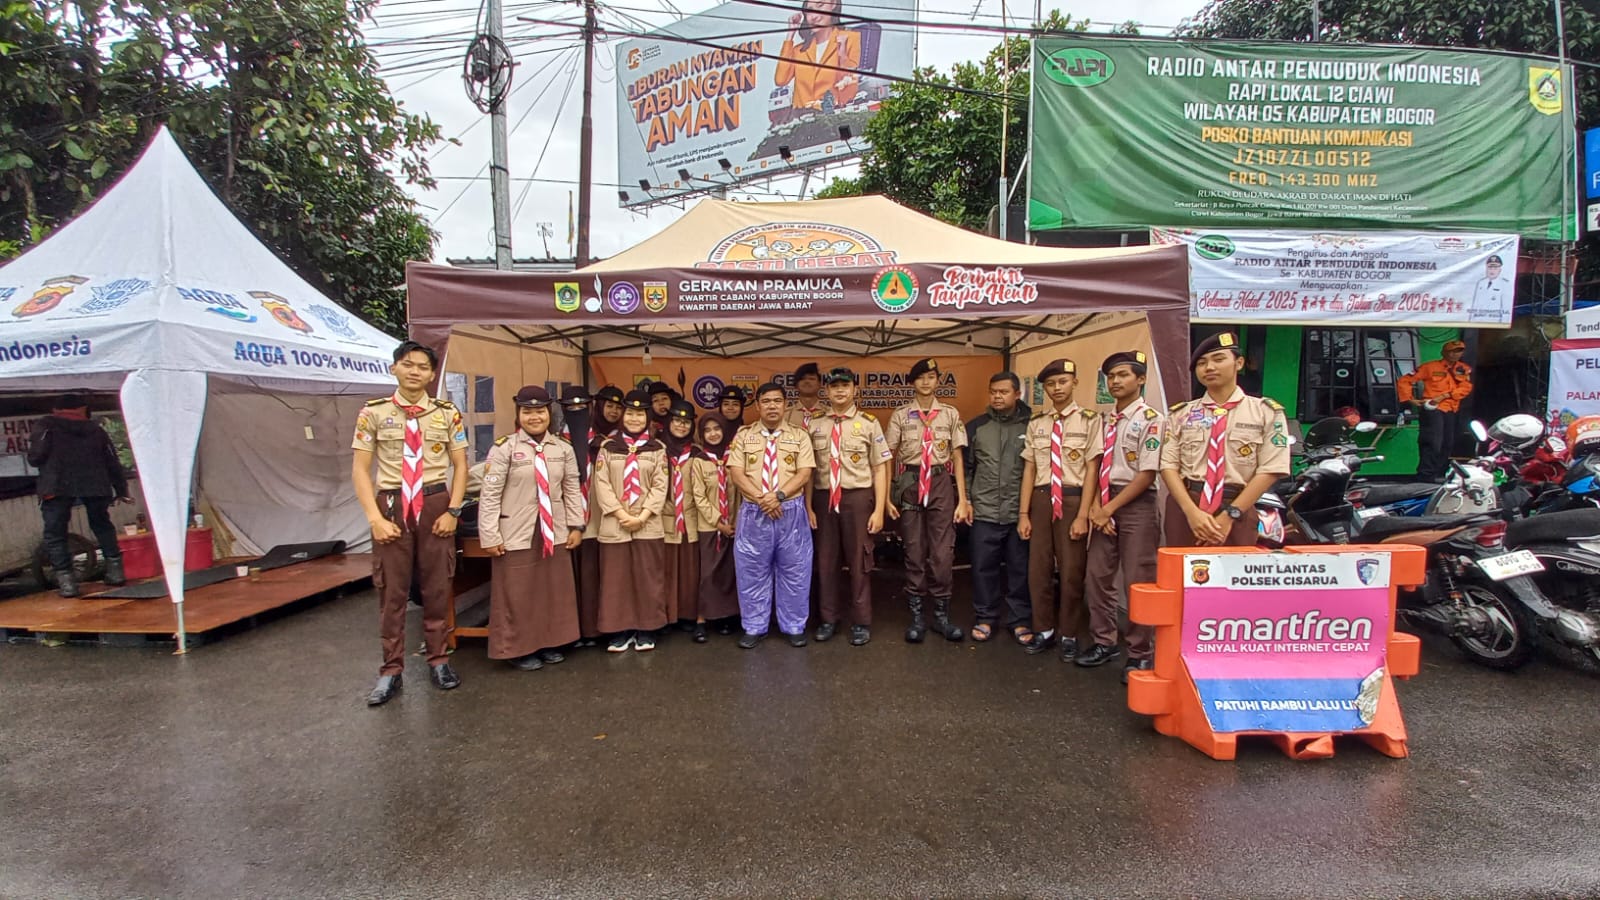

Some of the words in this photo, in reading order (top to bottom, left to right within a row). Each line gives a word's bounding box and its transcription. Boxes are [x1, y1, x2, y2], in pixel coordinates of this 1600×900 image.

[627, 59, 689, 101] LIBURAN
[691, 40, 763, 75] NYAMAN
[1147, 57, 1205, 77] RADIO
[1211, 58, 1279, 79] ANTAR
[1283, 59, 1380, 81] PENDUDUK
[1388, 63, 1481, 86] INDONESIA
[633, 63, 757, 123] TABUNGAN
[1228, 84, 1266, 101] RAPI
[1271, 84, 1325, 102] LOKAL
[1328, 85, 1344, 102] 12
[1348, 86, 1394, 105] CIAWI
[1183, 102, 1258, 121] WILAYAH
[1262, 103, 1282, 121] 05
[1287, 103, 1380, 124] KABUPATEN
[1385, 108, 1435, 125] BOGOR
[646, 94, 741, 152] AMAN
[1201, 127, 1249, 143] POSKO
[1251, 128, 1321, 145] BANTUAN
[1324, 129, 1413, 147] KOMUNIKASI
[1279, 173, 1340, 188] 143.300
[1347, 174, 1378, 188] MHZ
[1197, 190, 1230, 198] RUKUN
[1275, 192, 1306, 200] AKRAB
[1309, 192, 1319, 200] DI
[1320, 192, 1352, 200] DARAT
[1353, 193, 1377, 201] IMAN
[1390, 193, 1412, 201] HATI
[796, 252, 894, 268] HEBAT
[1287, 248, 1328, 258] Pengurus
[1330, 249, 1349, 259] dan
[1350, 250, 1389, 260] Anggota
[1234, 258, 1271, 267] RADIO
[1274, 259, 1311, 268] ANTAR
[1314, 259, 1375, 269] PENDUDUK
[1379, 261, 1437, 271] INDONESIA
[944, 266, 1022, 288] Berbakti
[1298, 270, 1352, 279] KABUPATEN
[1354, 271, 1391, 280] BOGOR
[679, 280, 758, 291] GERAKAN
[763, 278, 843, 290] PRAMUKA
[1300, 282, 1363, 292] Mengucapkan
[759, 292, 810, 300] KABUPATEN
[928, 282, 984, 309] Tanpa
[985, 282, 1037, 305] Henti
[1266, 291, 1298, 310] 2025
[1398, 292, 1430, 312] 2026
[679, 303, 718, 311] KWARTIR
[720, 303, 756, 311] DAERAH
[758, 302, 782, 310] JAWA
[234, 341, 287, 367] AQUA
[290, 350, 338, 369] 100%
[340, 356, 383, 373] Murni
[1244, 565, 1275, 574] UNIT
[1276, 564, 1327, 574] LANTAS
[1231, 576, 1281, 586] POLSEK
[1283, 576, 1338, 586] CISARUA
[1197, 610, 1373, 641] smartfren
[1196, 643, 1238, 653] SINYAL
[1240, 643, 1272, 653] KUAT
[1274, 643, 1331, 652] INTERNET
[1332, 642, 1371, 652] CEPAT
[1214, 700, 1260, 711] PATUHI
[1262, 700, 1308, 711] RAMBU
[1309, 700, 1340, 711] LALU
